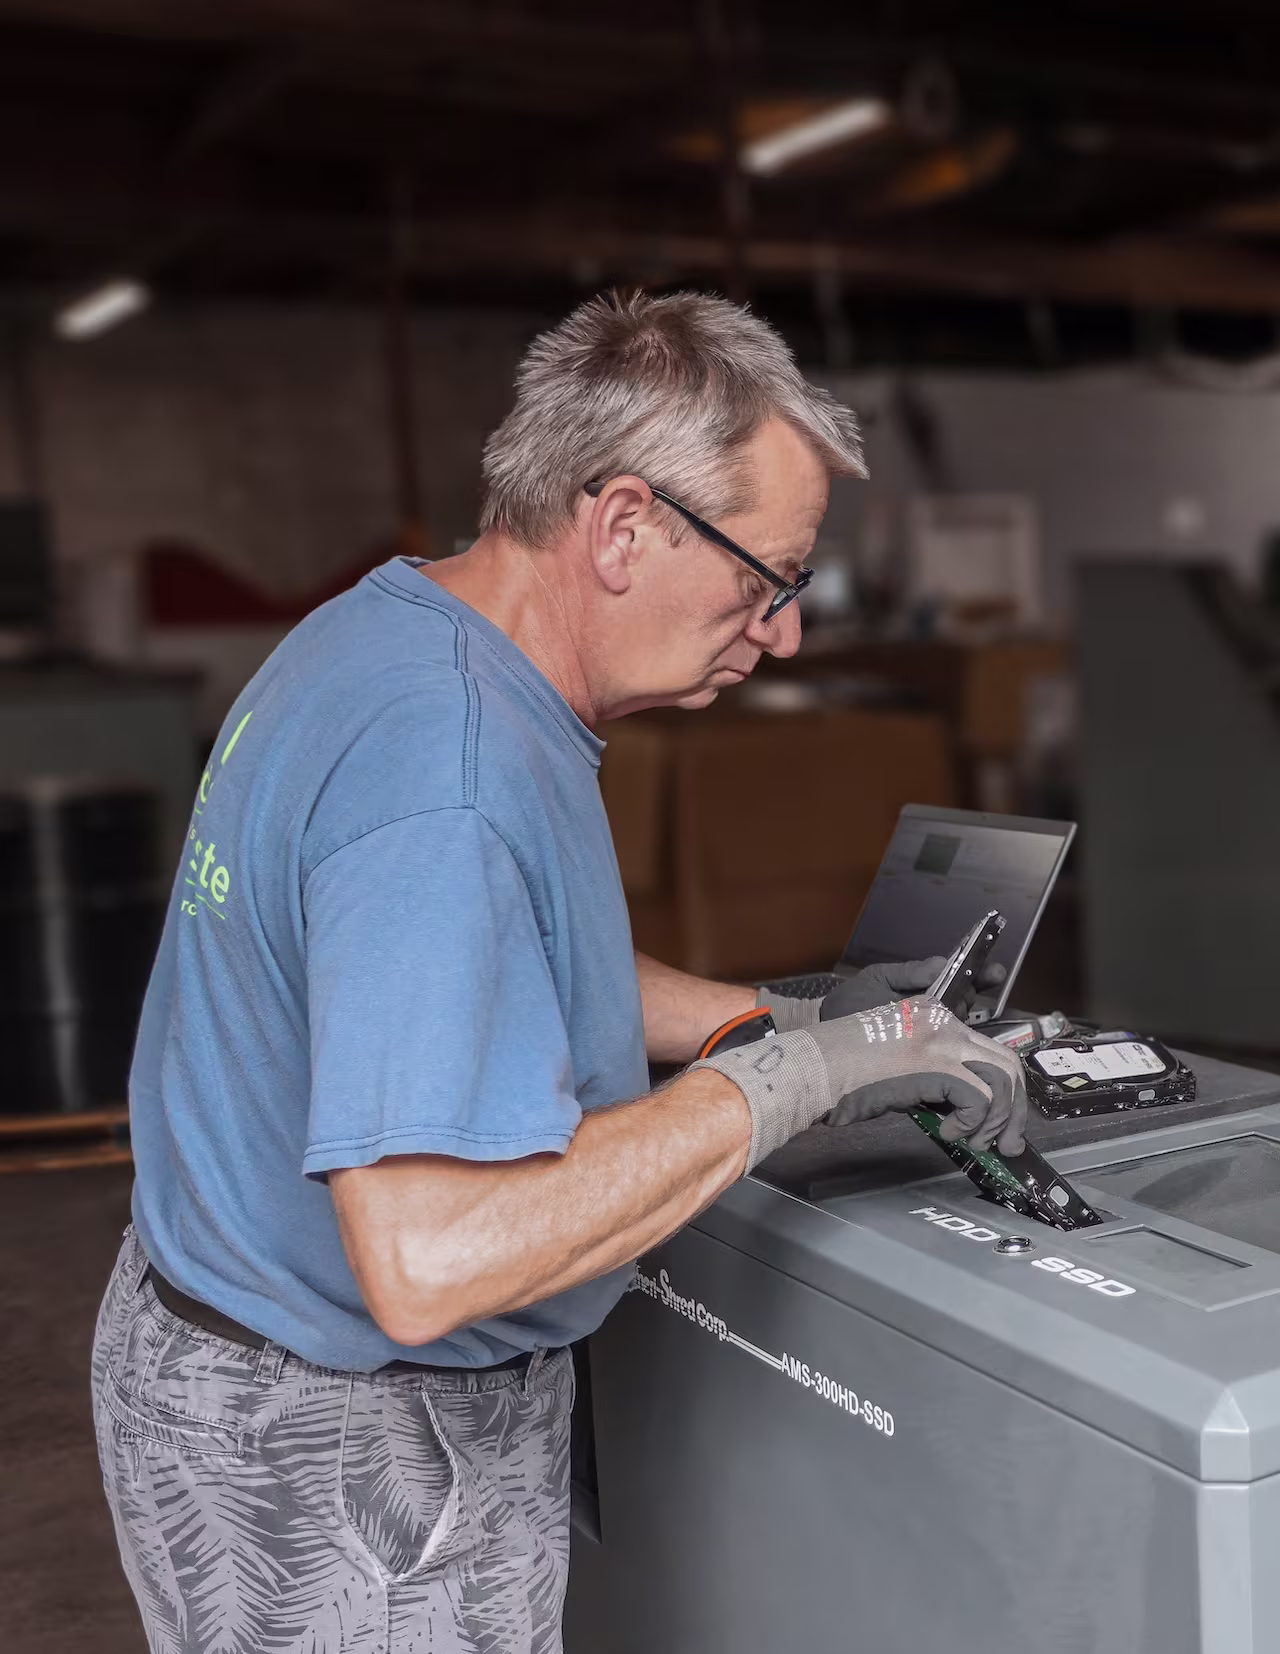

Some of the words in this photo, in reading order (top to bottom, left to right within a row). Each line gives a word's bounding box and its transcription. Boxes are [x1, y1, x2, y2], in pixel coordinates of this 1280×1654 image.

[908, 1206, 1001, 1242] HDD
[1031, 1256, 1136, 1297] SSD
[781, 1351, 896, 1437] AMS-300HD-SSD
